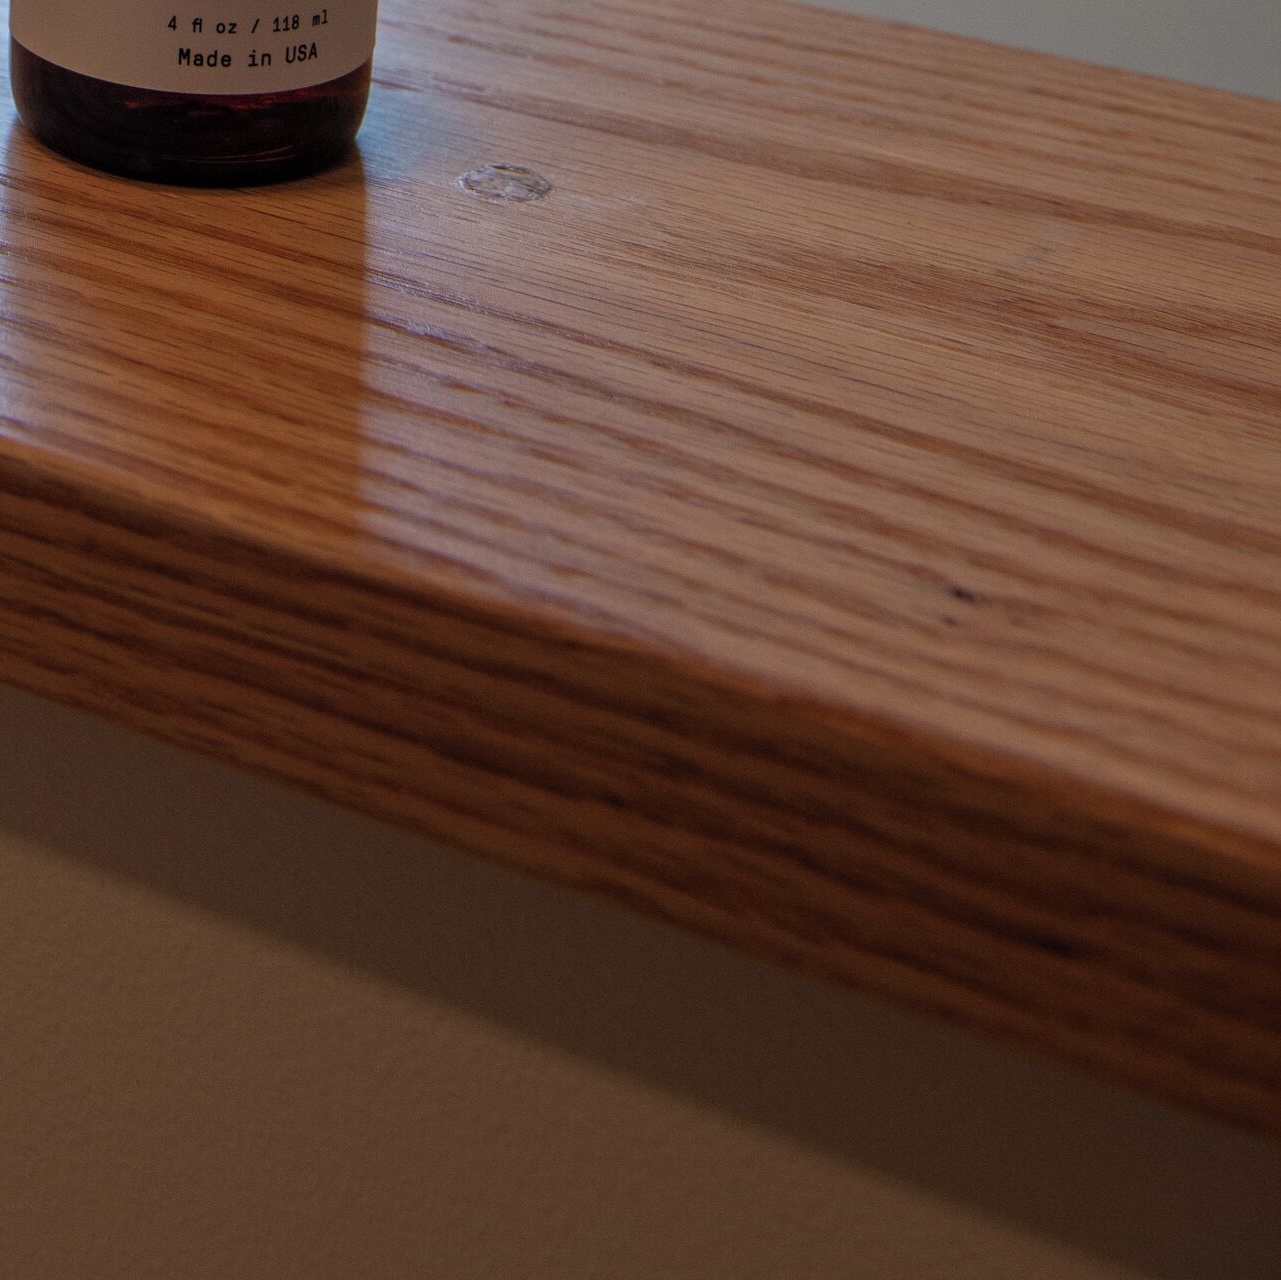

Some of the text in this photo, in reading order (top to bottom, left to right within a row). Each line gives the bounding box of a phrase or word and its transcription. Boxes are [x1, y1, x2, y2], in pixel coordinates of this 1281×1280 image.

[168, 9, 329, 34] 4 fl oz / 118 ml
[178, 42, 318, 67] Made in USA
